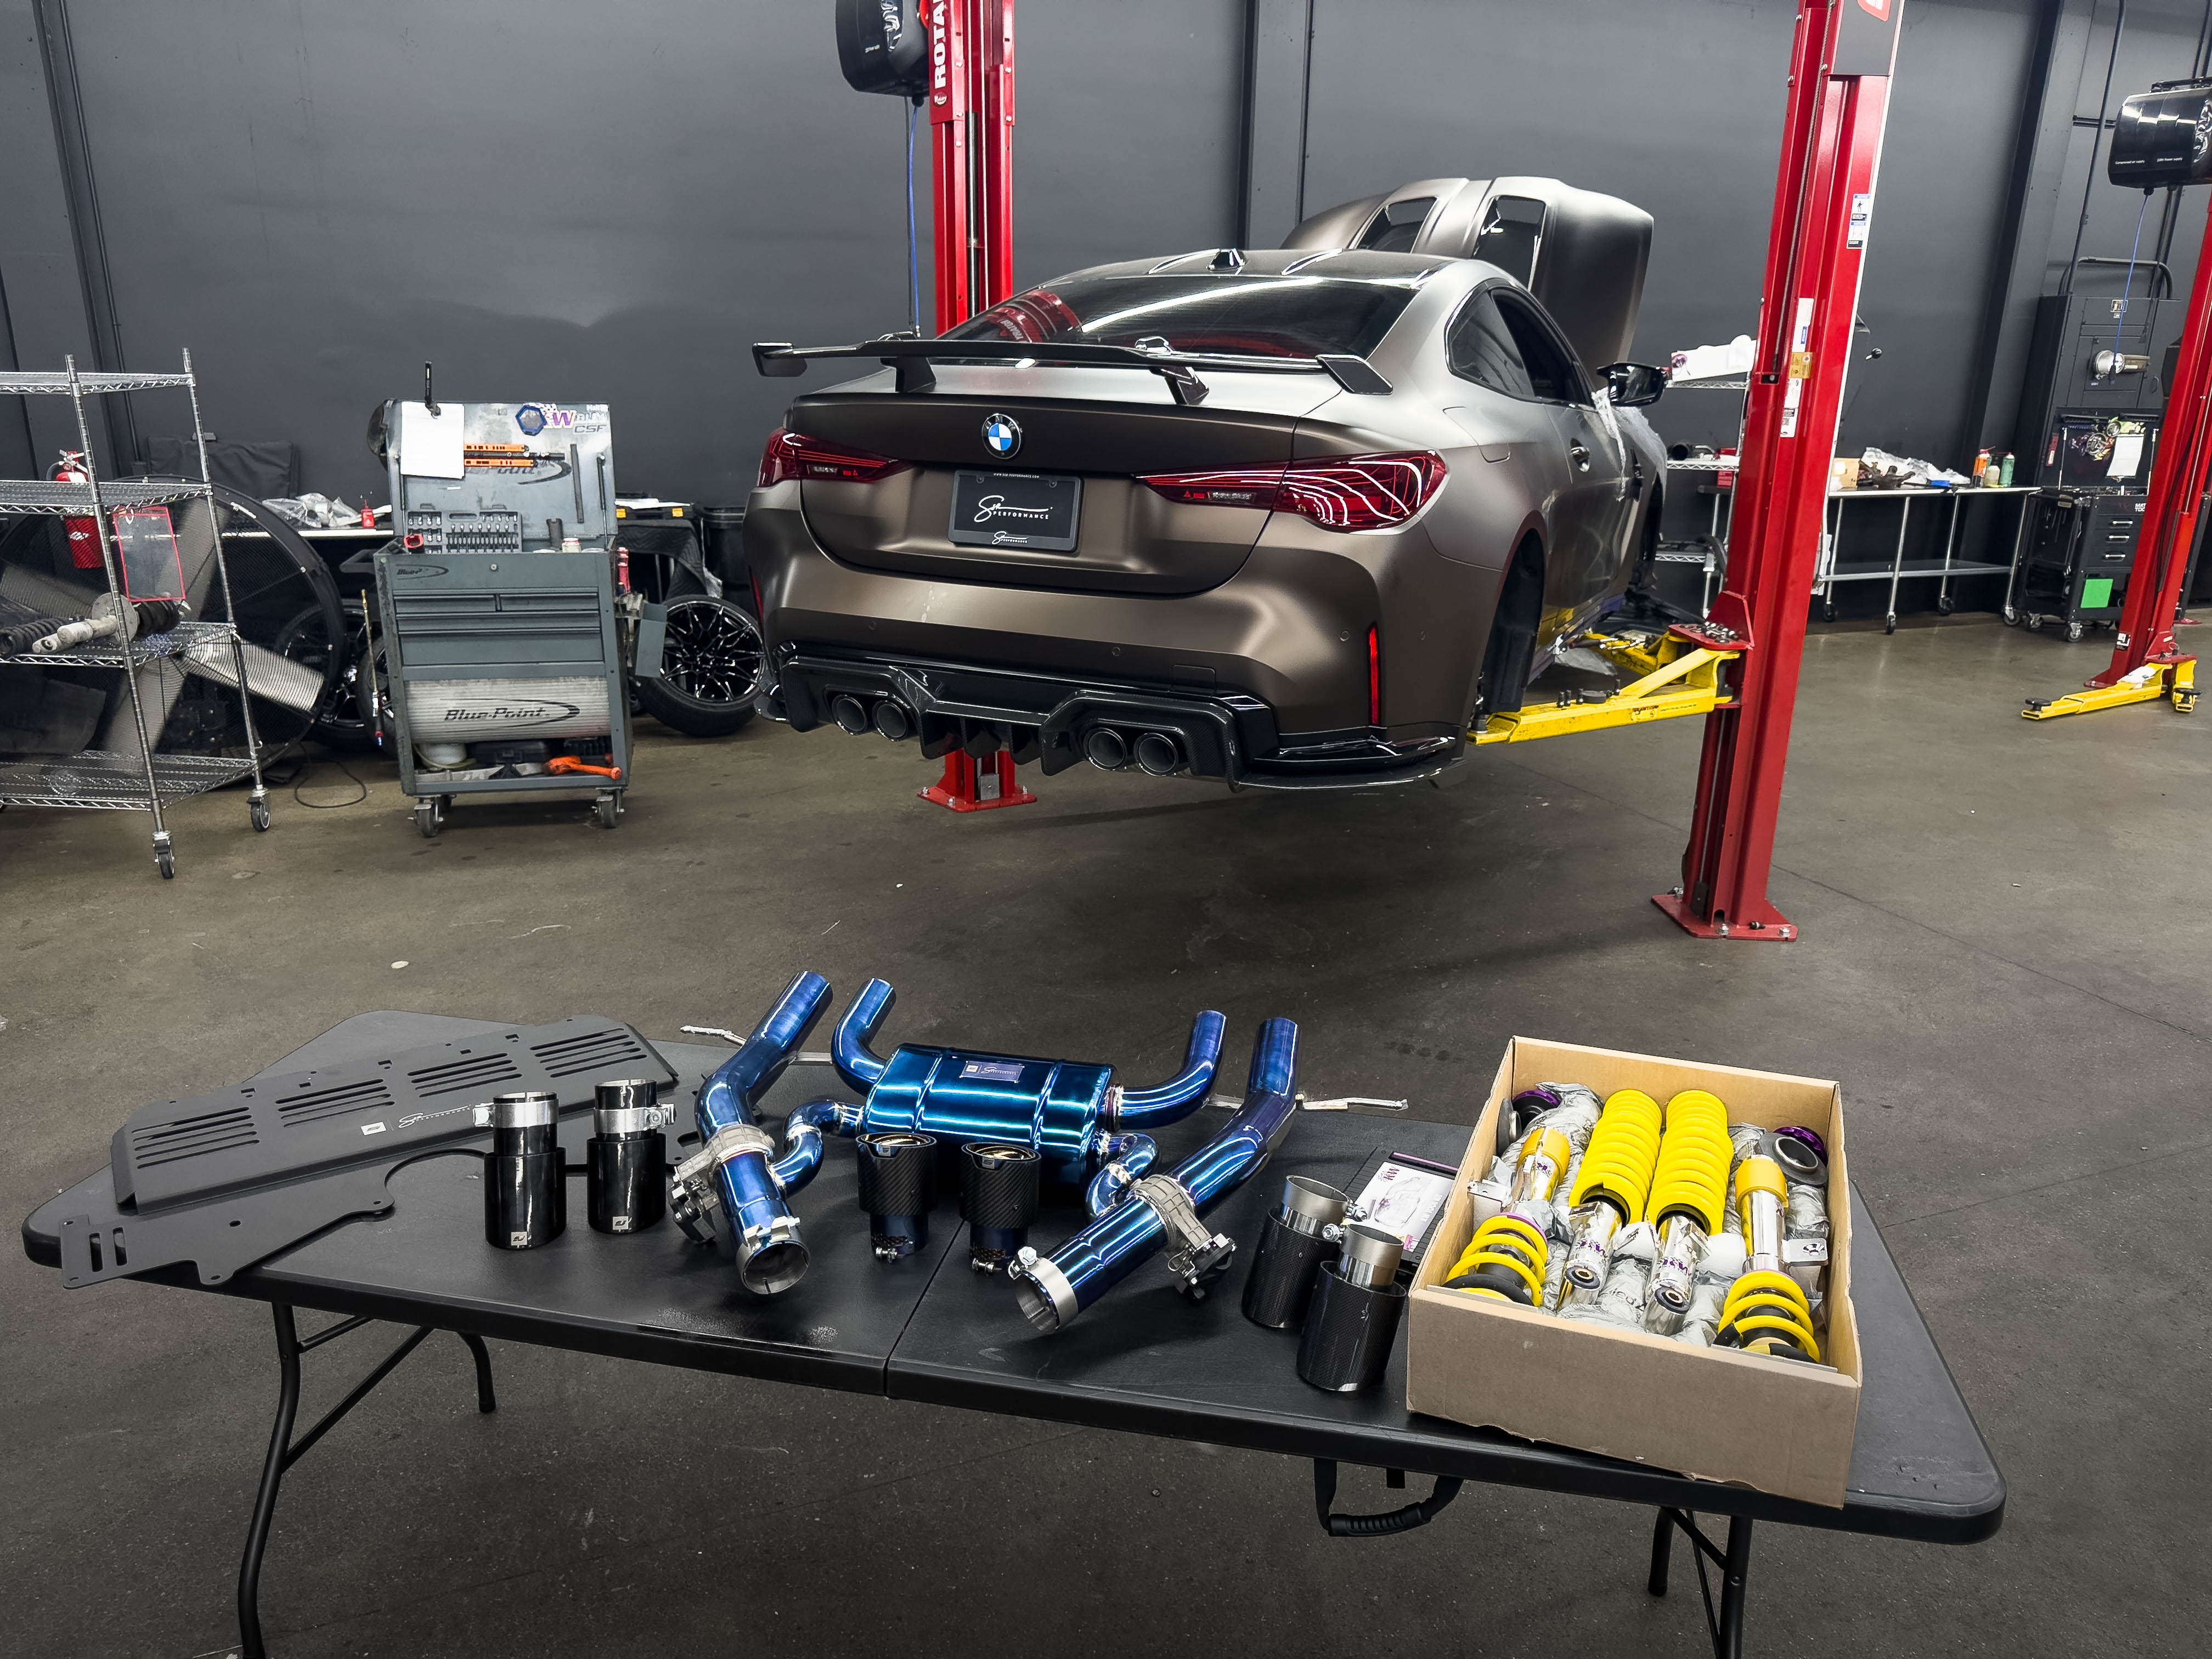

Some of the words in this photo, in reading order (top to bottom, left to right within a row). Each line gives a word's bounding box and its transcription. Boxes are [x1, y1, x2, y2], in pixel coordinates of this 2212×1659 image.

[933, 0, 946, 89] ROTA
[985, 415, 1016, 430] BMW
[574, 425, 607, 433] CSF
[993, 511, 1049, 520] PERFORMANCE
